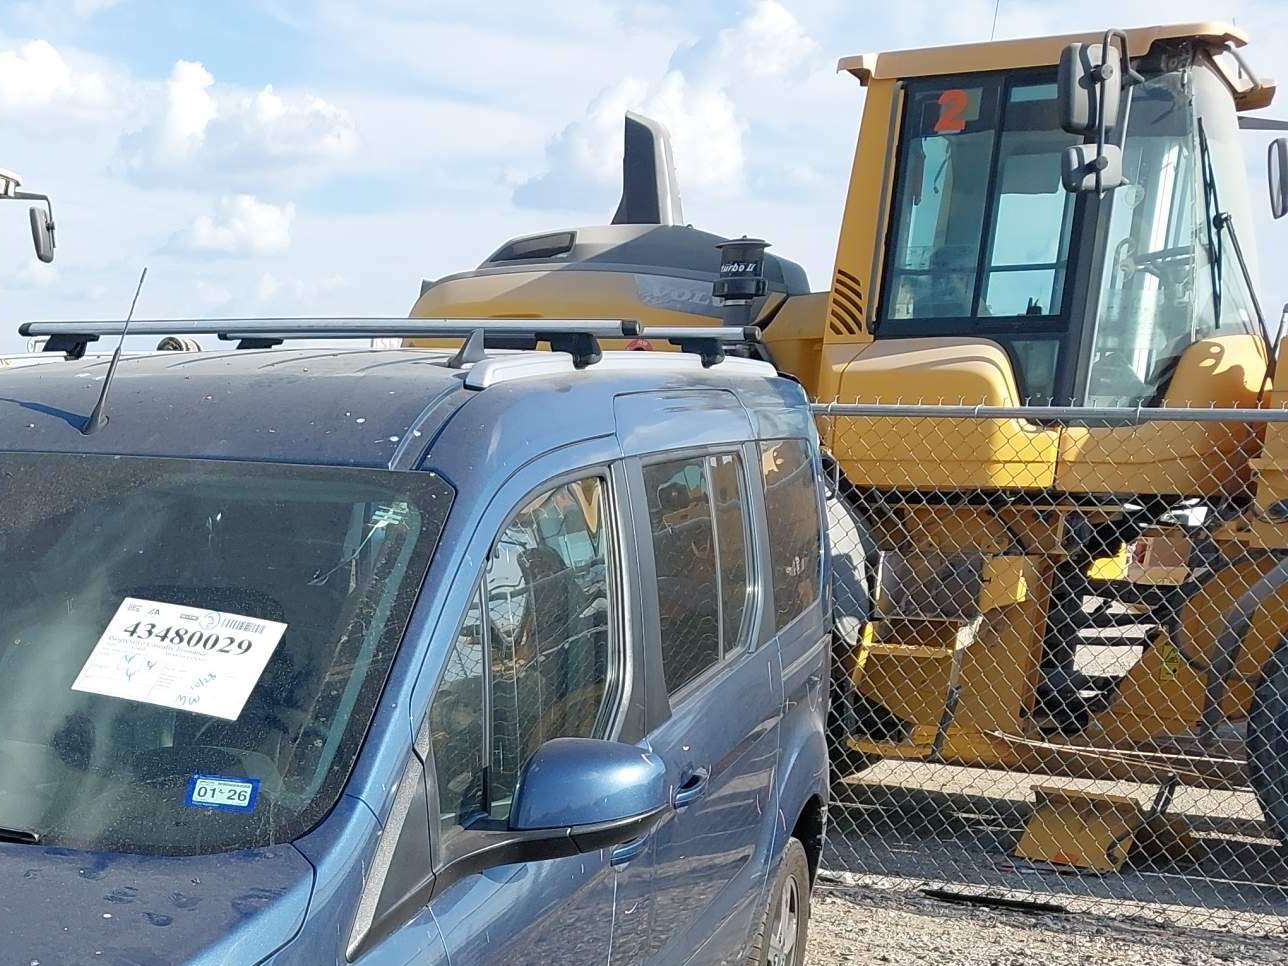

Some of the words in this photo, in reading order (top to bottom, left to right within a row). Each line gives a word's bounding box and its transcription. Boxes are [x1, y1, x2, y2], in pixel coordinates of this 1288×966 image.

[934, 89, 969, 134] 2
[123, 621, 253, 656] 43480029
[197, 786, 216, 798] 01
[226, 789, 248, 802] 26
